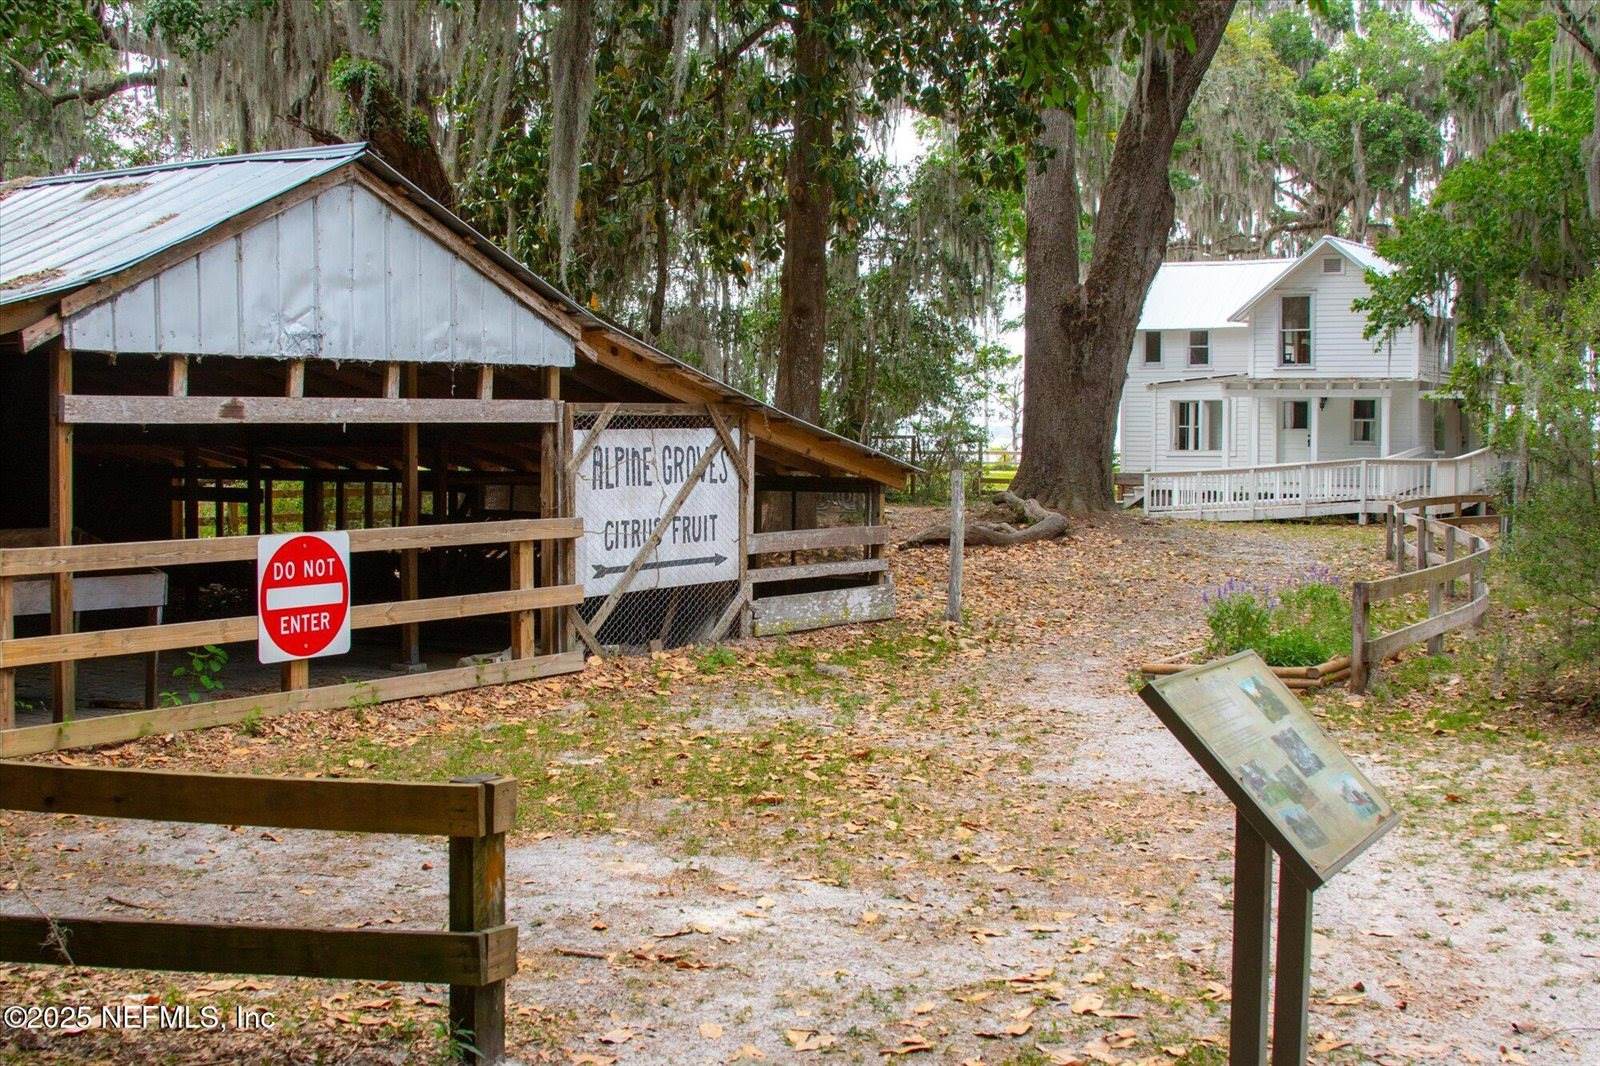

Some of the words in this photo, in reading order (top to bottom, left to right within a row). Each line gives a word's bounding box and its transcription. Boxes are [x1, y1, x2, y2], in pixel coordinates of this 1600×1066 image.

[604, 517, 662, 551] CITRU
[672, 514, 718, 545] FRUIT
[273, 561, 295, 580] DO
[303, 558, 335, 578] NOT
[280, 612, 330, 635] ENTER
